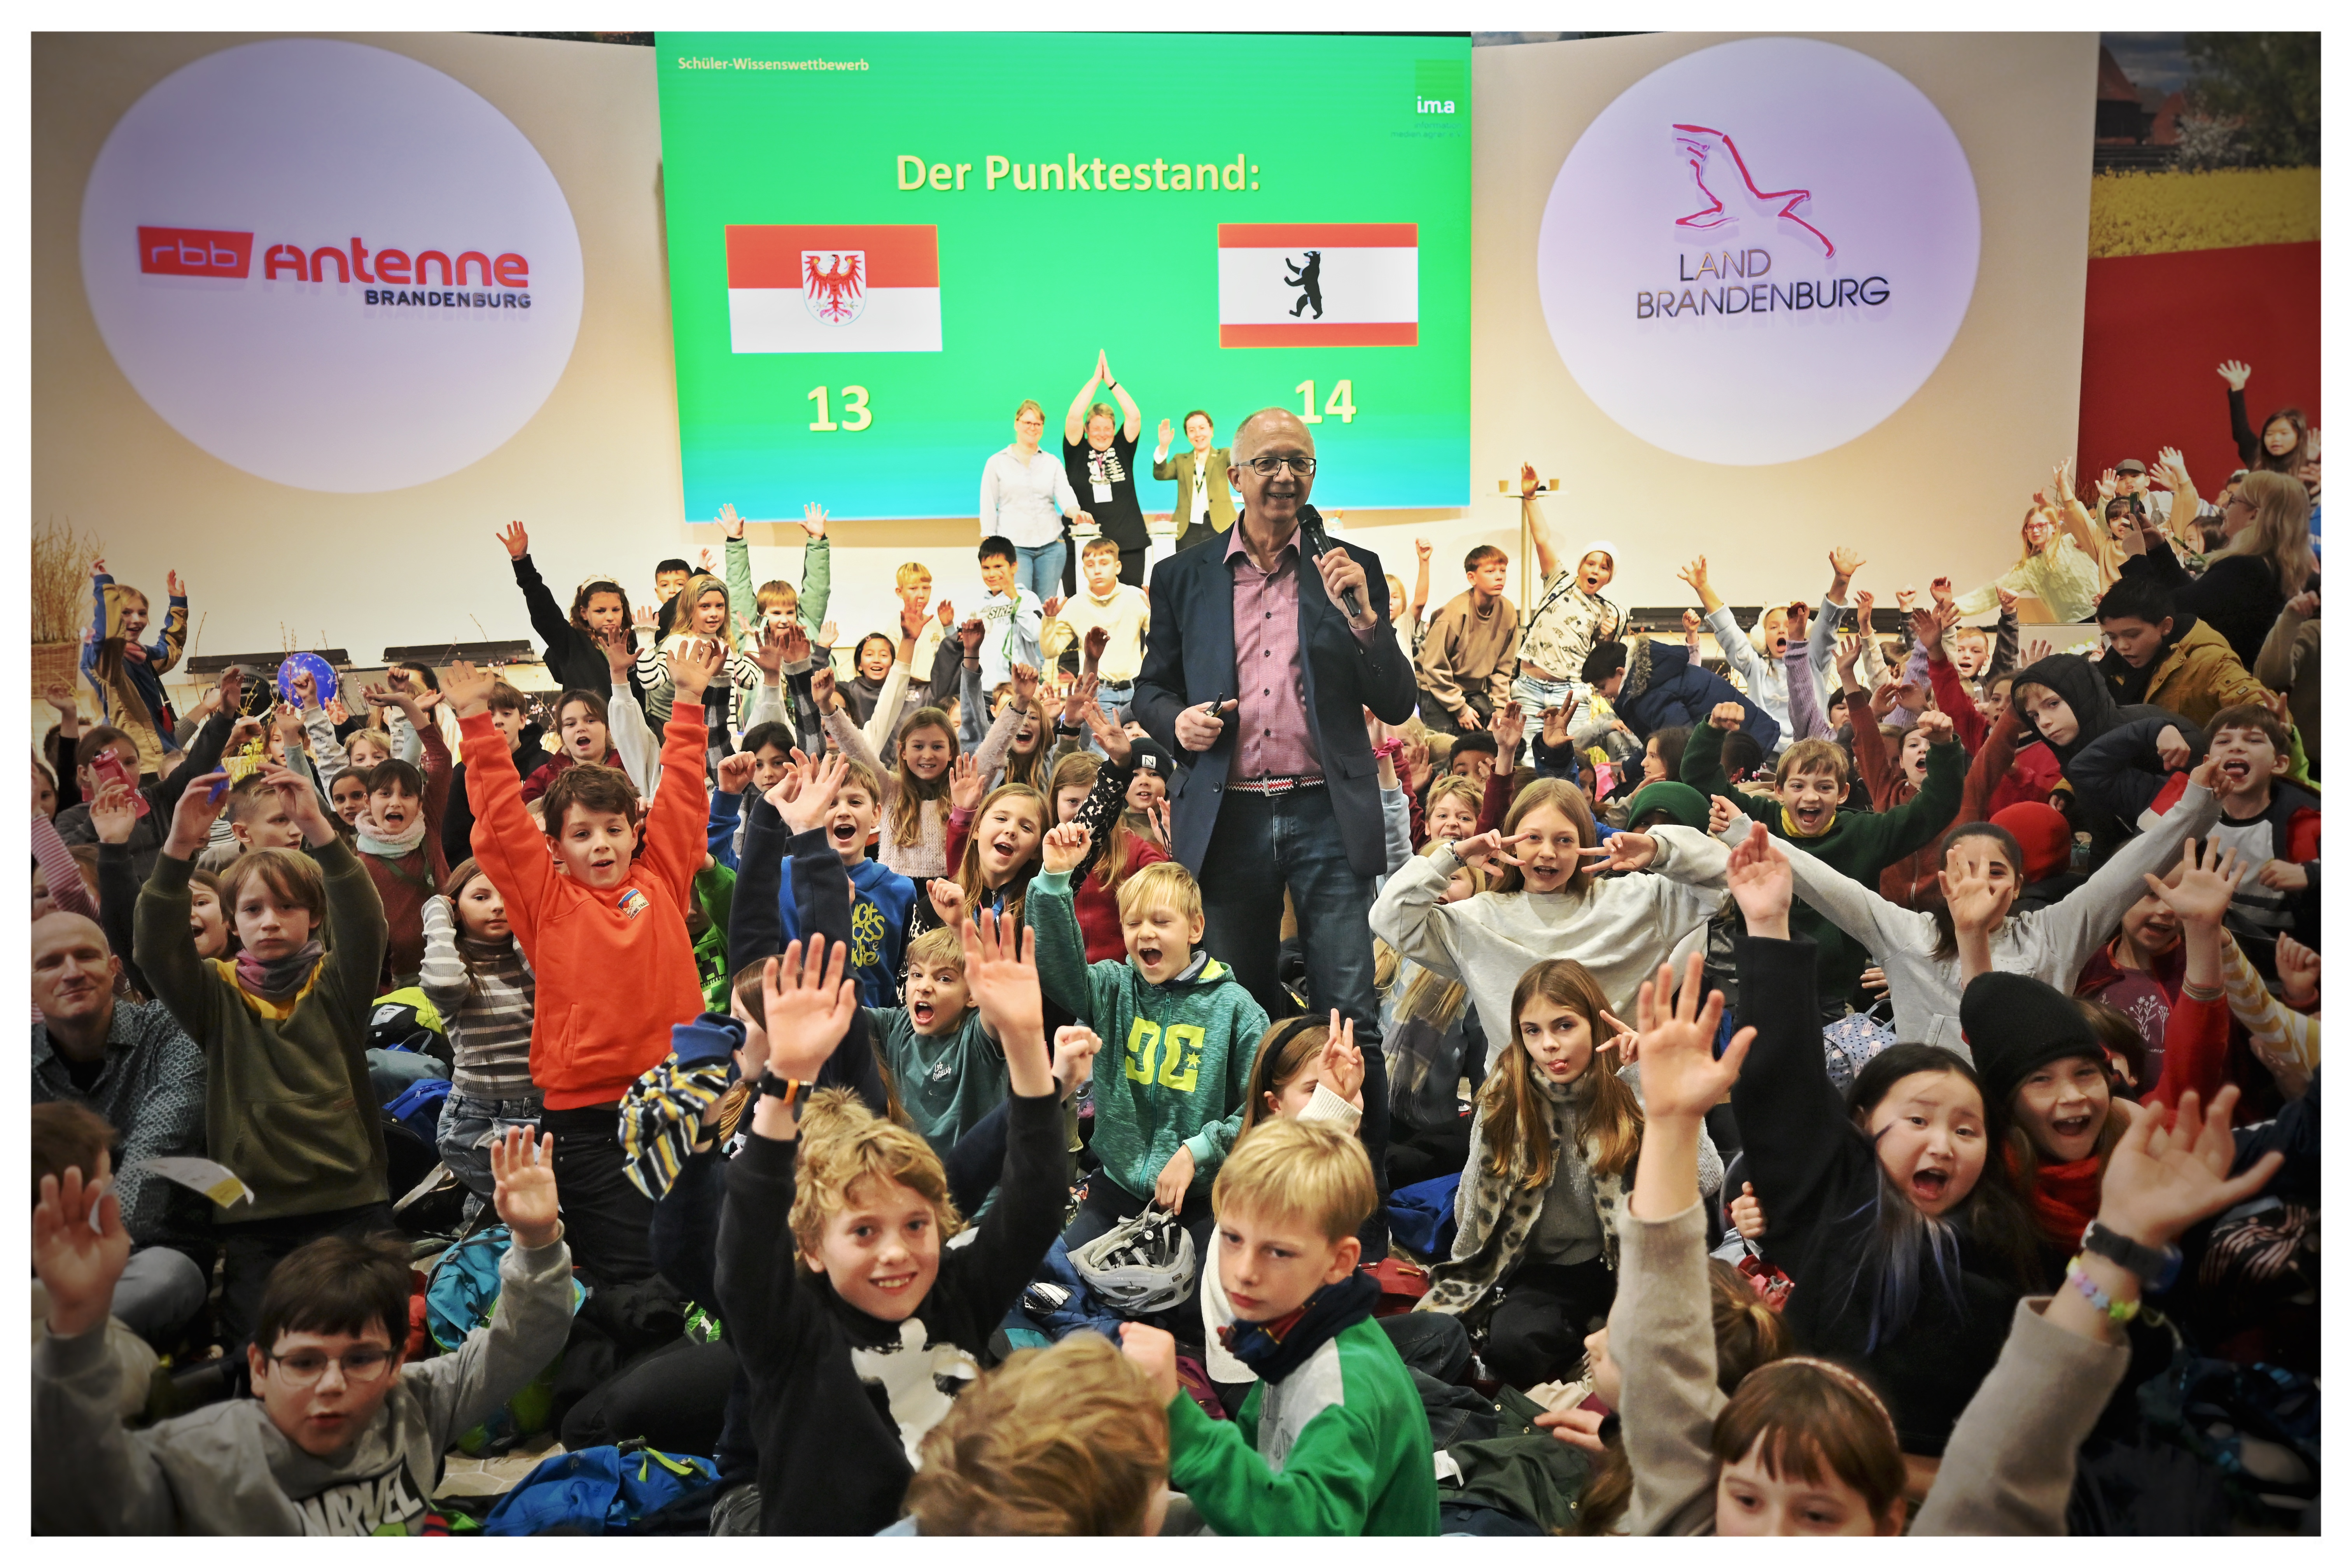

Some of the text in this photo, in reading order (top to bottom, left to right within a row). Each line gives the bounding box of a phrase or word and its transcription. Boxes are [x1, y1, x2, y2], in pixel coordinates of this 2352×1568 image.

[678, 56, 870, 71] Schüler-Wissenswettbewerb
[897, 152, 1260, 191] Der Punktestand:
[151, 238, 238, 267] rbb
[1680, 248, 1771, 281] LAND
[364, 289, 531, 309] BRANDENBURG
[1637, 276, 1890, 319] BRANDENBURG
[807, 385, 872, 432] 13
[1295, 379, 1357, 424] 14
[988, 604, 1014, 620] STRE
[1144, 756, 1153, 765] N
[630, 908, 639, 919] HIKING
[1125, 1016, 1205, 1093] DC
[292, 1462, 423, 1536] MARVEL
